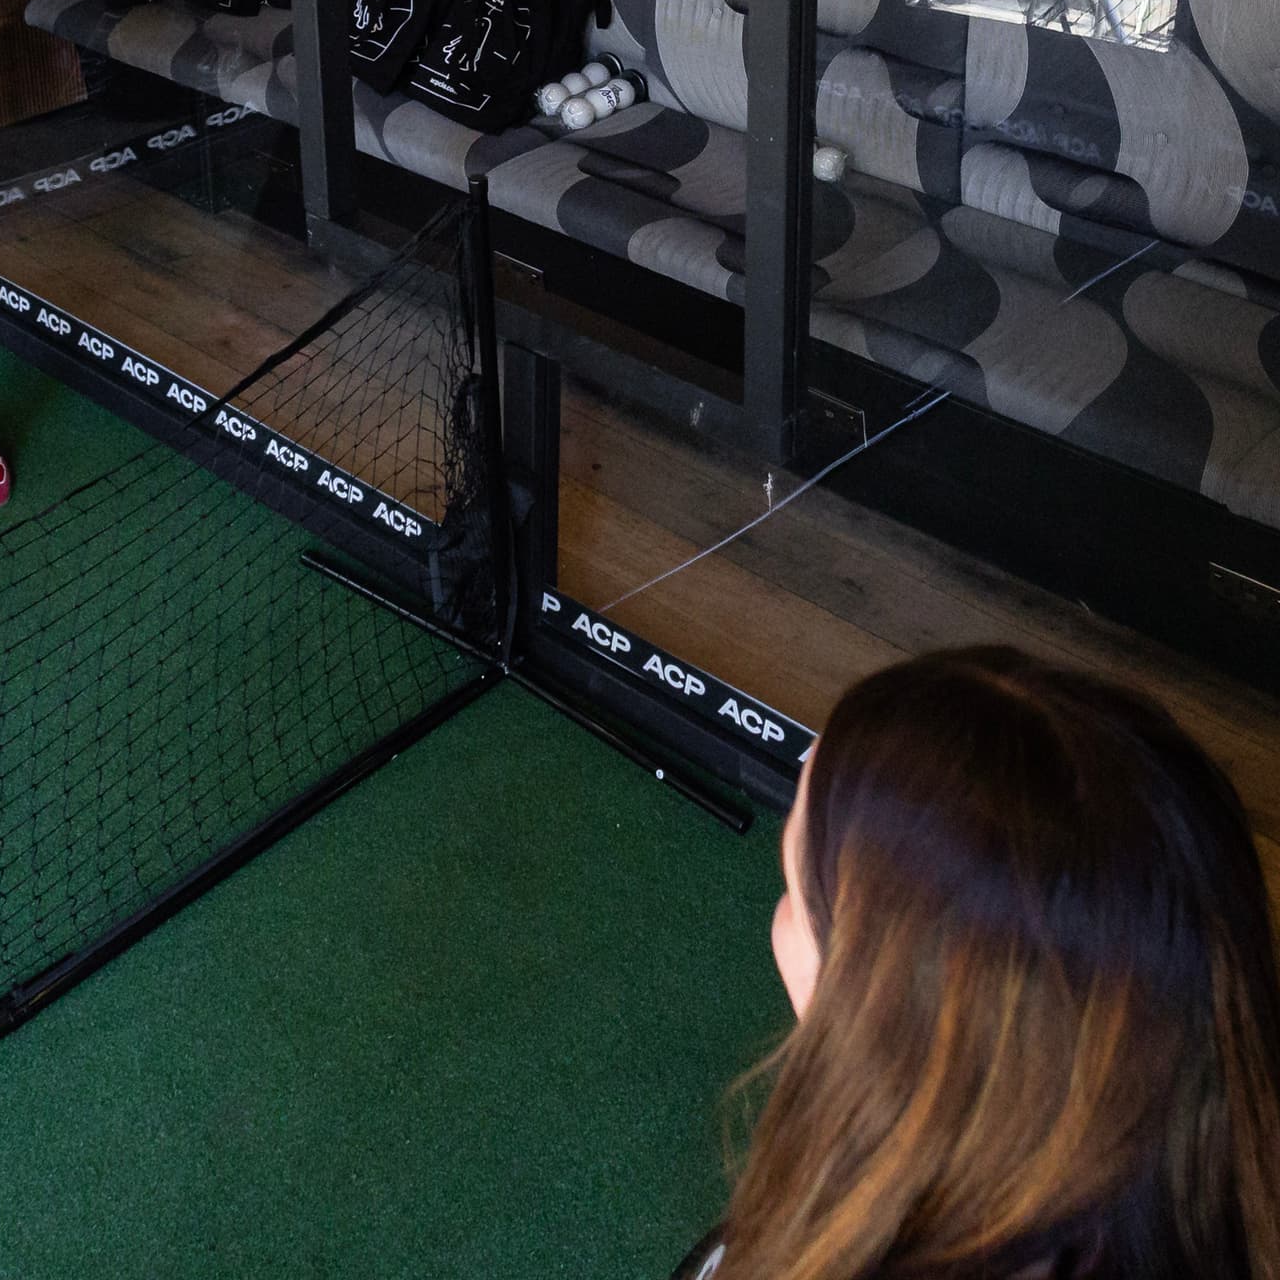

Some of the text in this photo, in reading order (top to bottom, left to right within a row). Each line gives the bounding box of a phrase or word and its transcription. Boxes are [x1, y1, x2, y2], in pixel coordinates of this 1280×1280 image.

[36, 308, 72, 336] ACP
[78, 331, 115, 361] ACP
[121, 356, 160, 386] ACP
[166, 382, 207, 414] ACP
[214, 409, 257, 441] ACP
[265, 438, 309, 472] ACP
[316, 470, 364, 504] ACP
[372, 501, 423, 538] ACP
[571, 613, 785, 742] ACP ACP ACP
